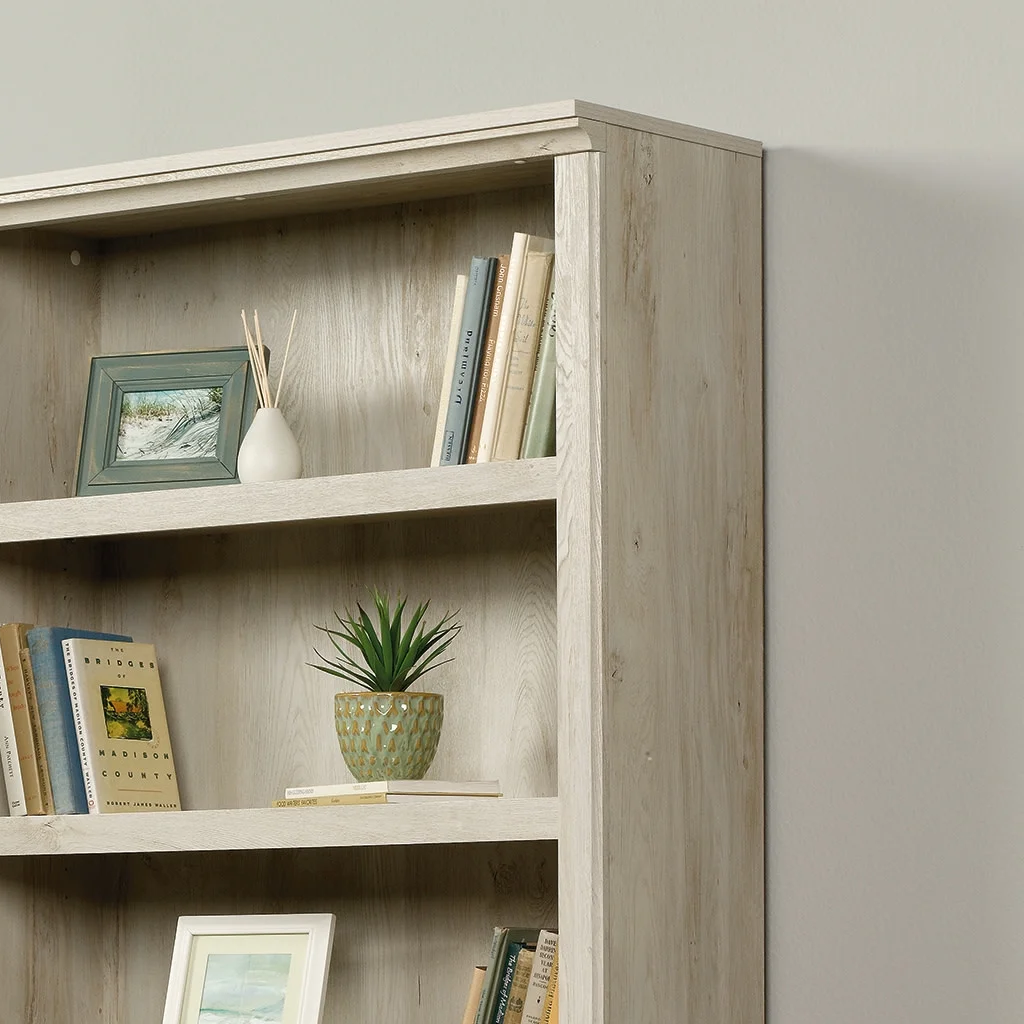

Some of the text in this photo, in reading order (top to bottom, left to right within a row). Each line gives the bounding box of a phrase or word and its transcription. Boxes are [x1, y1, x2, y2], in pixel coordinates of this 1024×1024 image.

[492, 263, 507, 317] John Grisham
[66, 658, 77, 690] BRIDGES
[84, 658, 155, 668] BRIDGES
[71, 691, 78, 701] OF
[73, 702, 84, 735] MADISON
[78, 737, 89, 766] COUNTY
[99, 750, 170, 760] MADISON
[84, 771, 94, 798] WALLER
[102, 770, 172, 780] COUNTY
[507, 953, 516, 967] The
[502, 966, 513, 989] Bridges
[498, 989, 508, 997] of
[494, 996, 506, 1023] Madison
